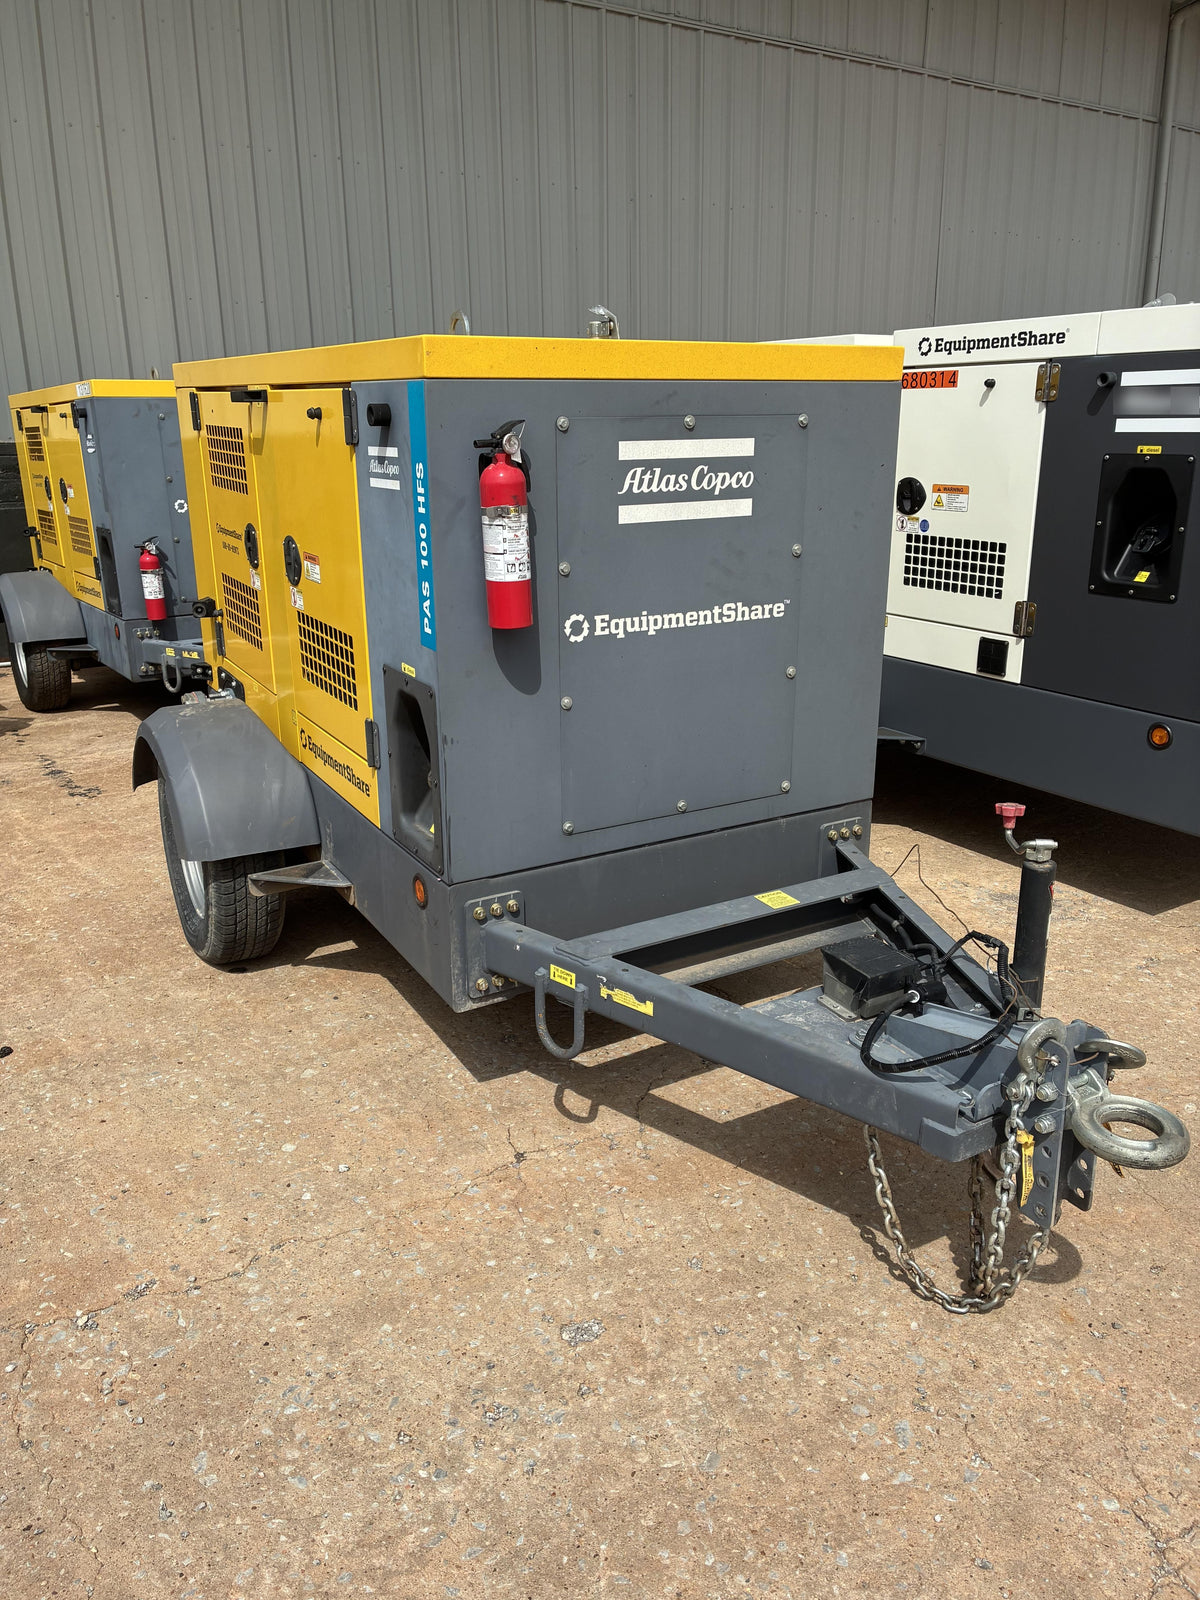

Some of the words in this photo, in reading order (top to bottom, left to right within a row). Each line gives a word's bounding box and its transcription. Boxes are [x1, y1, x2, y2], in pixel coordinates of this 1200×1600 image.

[934, 330, 1066, 355] EquipmentShare
[901, 371, 957, 389] 680314
[369, 459, 384, 473] Atlas
[384, 460, 400, 477] Copco
[617, 467, 688, 495] Atlas
[690, 464, 754, 495] Copco
[415, 462, 426, 514] HFS
[418, 523, 429, 569] 100
[421, 580, 432, 635] PAS
[593, 601, 785, 639] EquipmentShare
[307, 735, 371, 798] EquipmentShare
